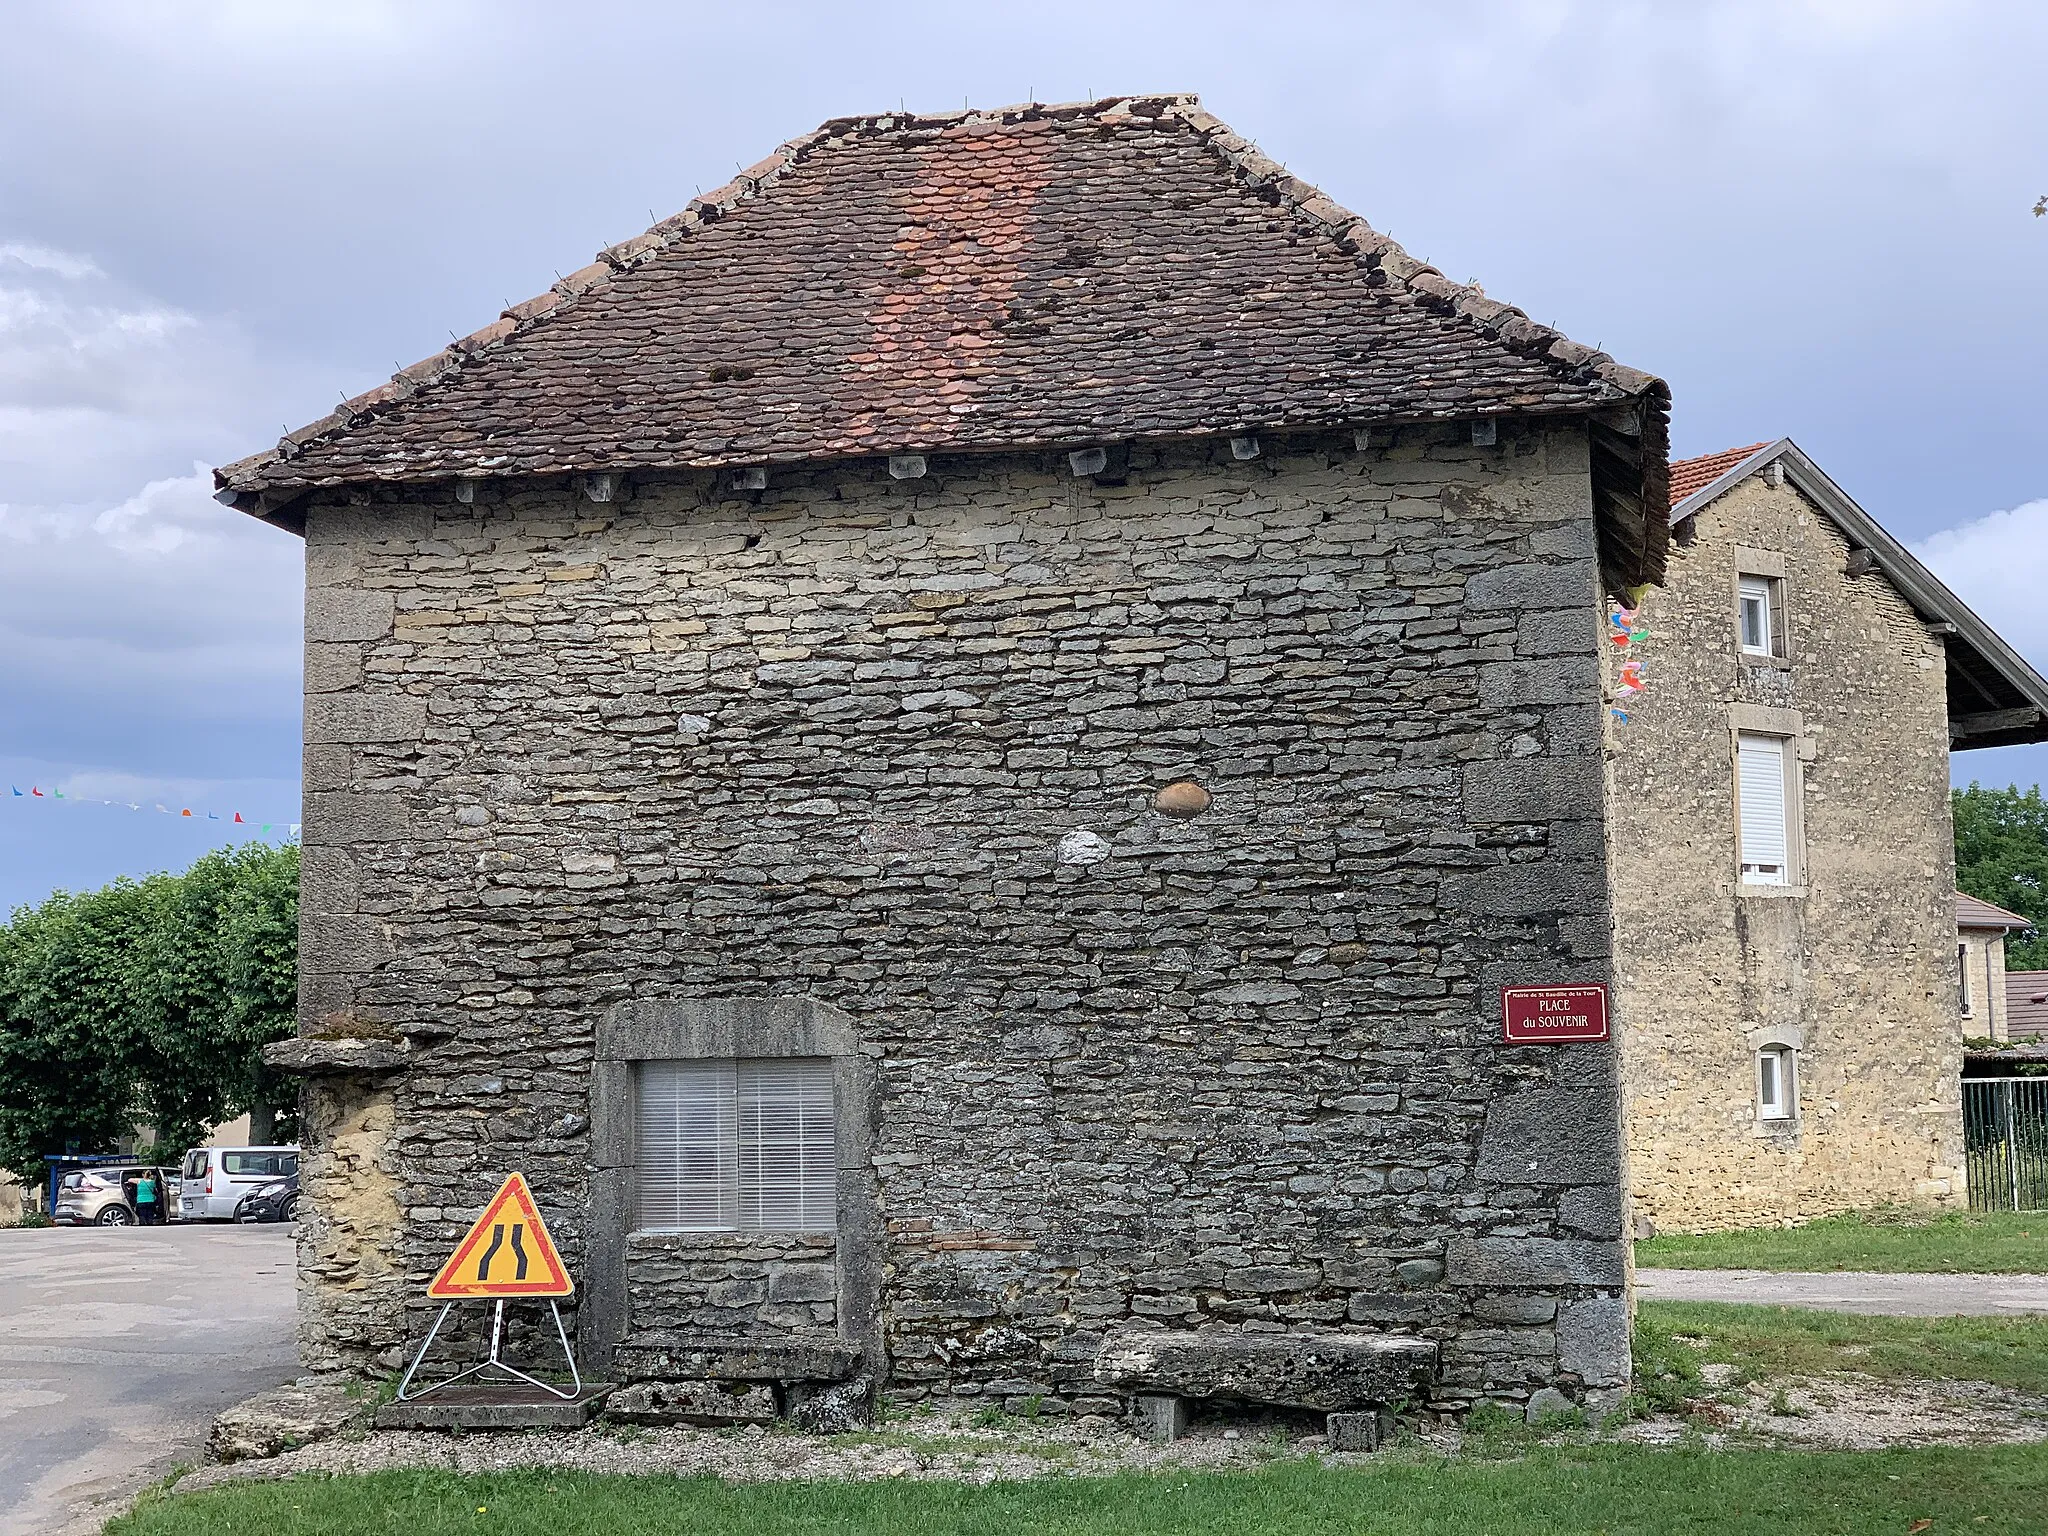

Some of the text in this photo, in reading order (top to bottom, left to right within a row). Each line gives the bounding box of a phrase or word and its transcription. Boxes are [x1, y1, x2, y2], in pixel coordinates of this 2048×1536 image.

[1540, 999, 1571, 1011] PLACE
[1523, 1015, 1588, 1028] du SOUVENIR
